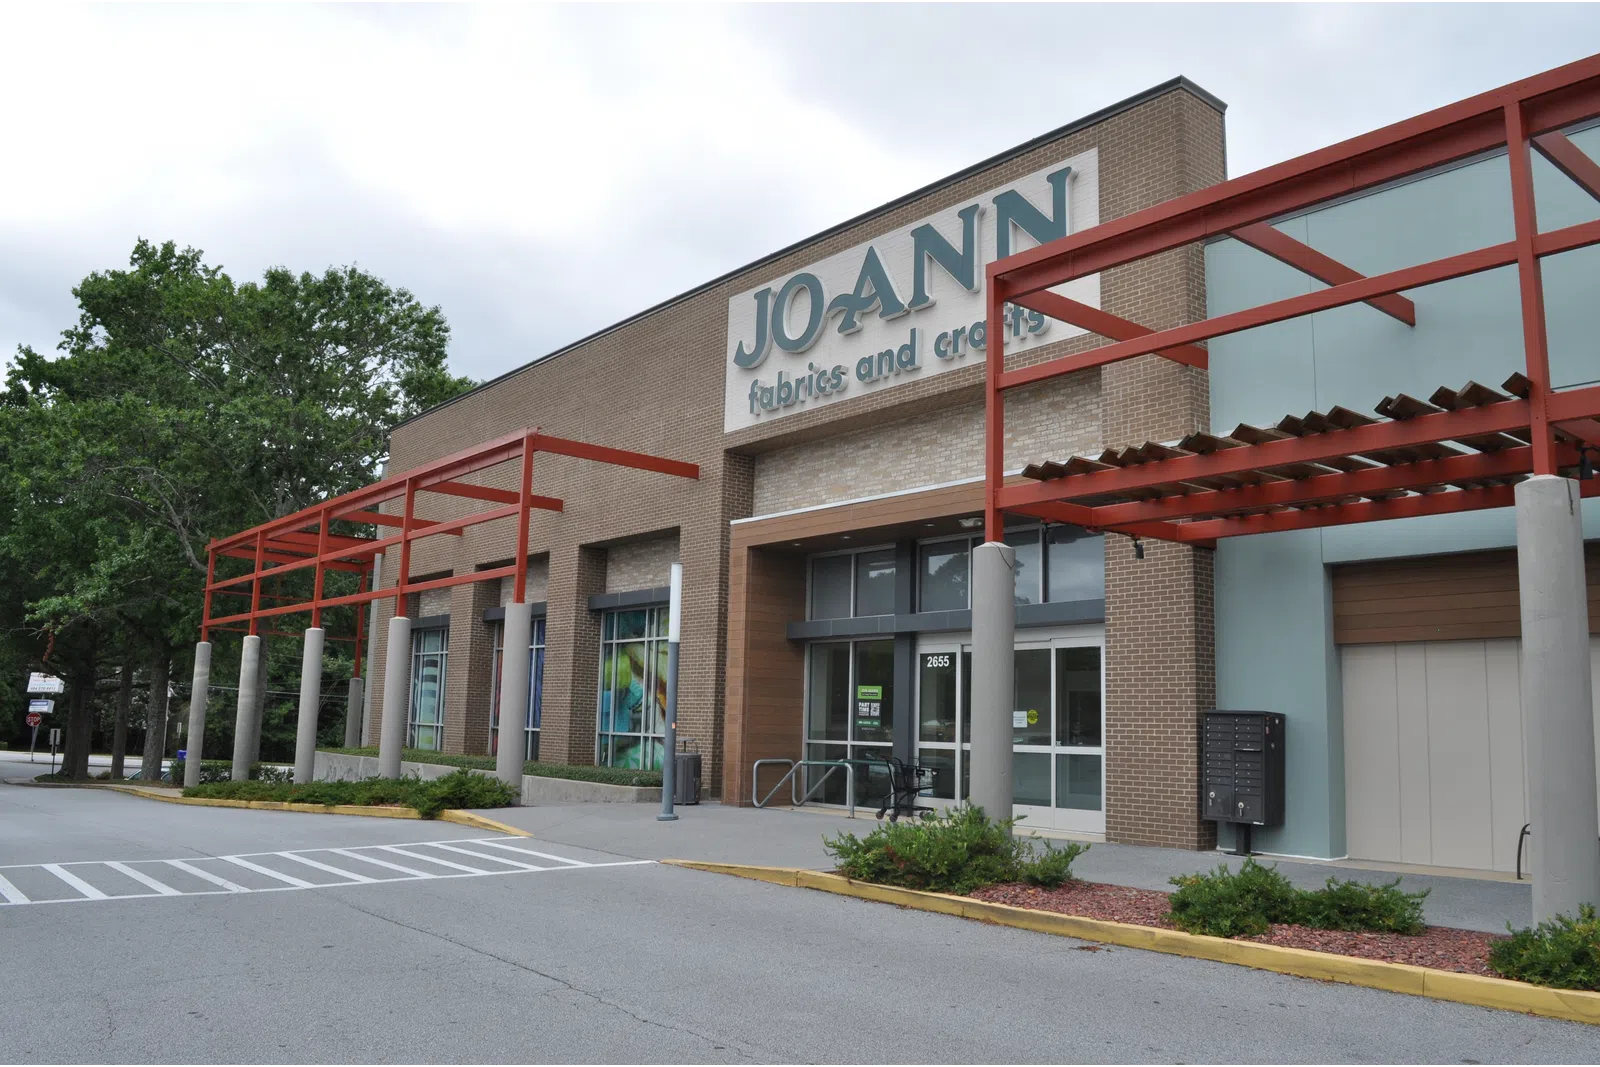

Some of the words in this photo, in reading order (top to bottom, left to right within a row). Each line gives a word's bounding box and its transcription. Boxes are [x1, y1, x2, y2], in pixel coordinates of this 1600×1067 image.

[748, 360, 846, 415] fabrics
[855, 327, 921, 383] and
[934, 302, 1049, 359] crats
[927, 655, 949, 667] 2655
